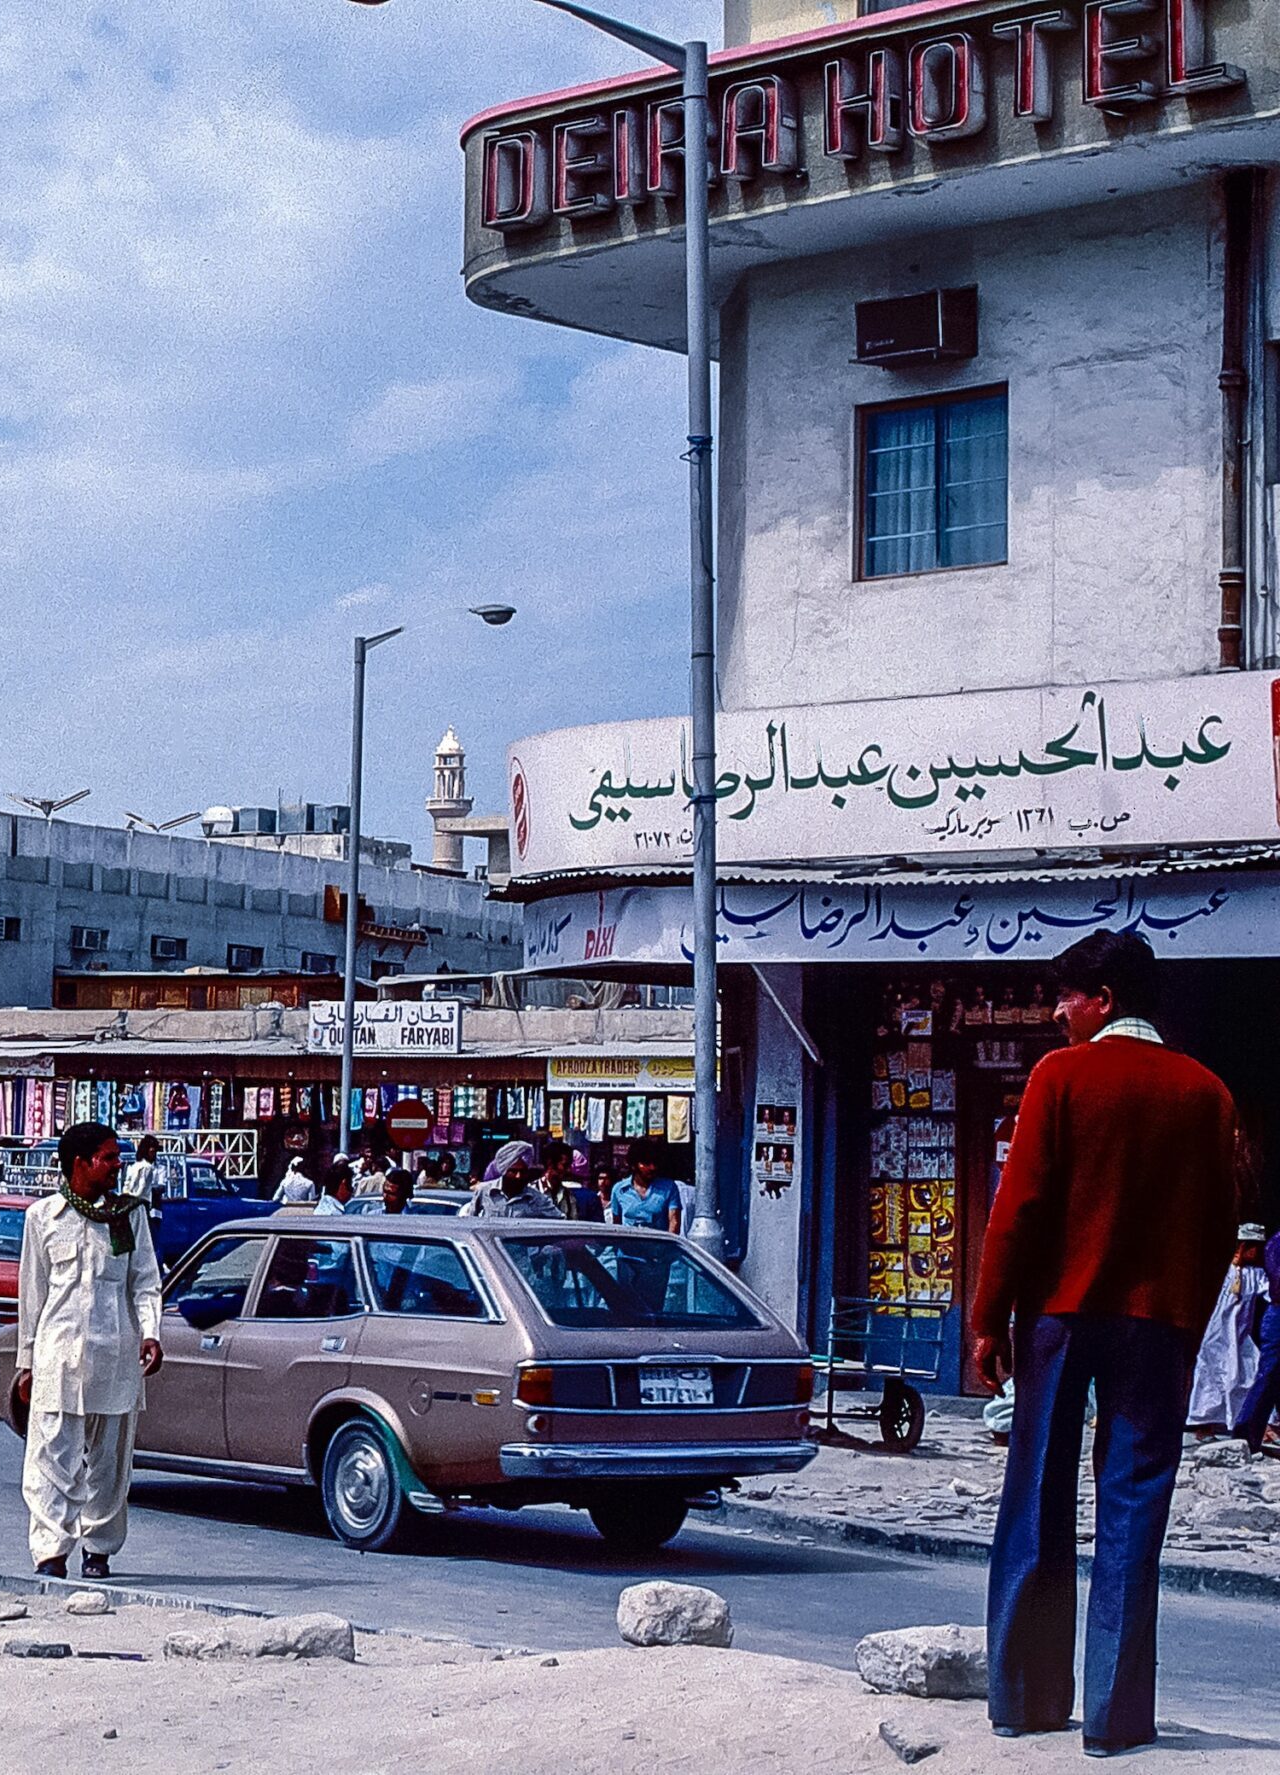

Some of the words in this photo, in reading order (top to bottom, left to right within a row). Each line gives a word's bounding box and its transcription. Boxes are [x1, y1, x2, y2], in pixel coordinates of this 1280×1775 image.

[483, 72, 786, 230] DEIRA
[823, 0, 1230, 156] HOTEL
[329, 1027, 376, 1046] QUTAN
[401, 1027, 454, 1046] FARYABI
[556, 1059, 597, 1074] AFROOZA
[599, 1059, 640, 1075] TRADERS
